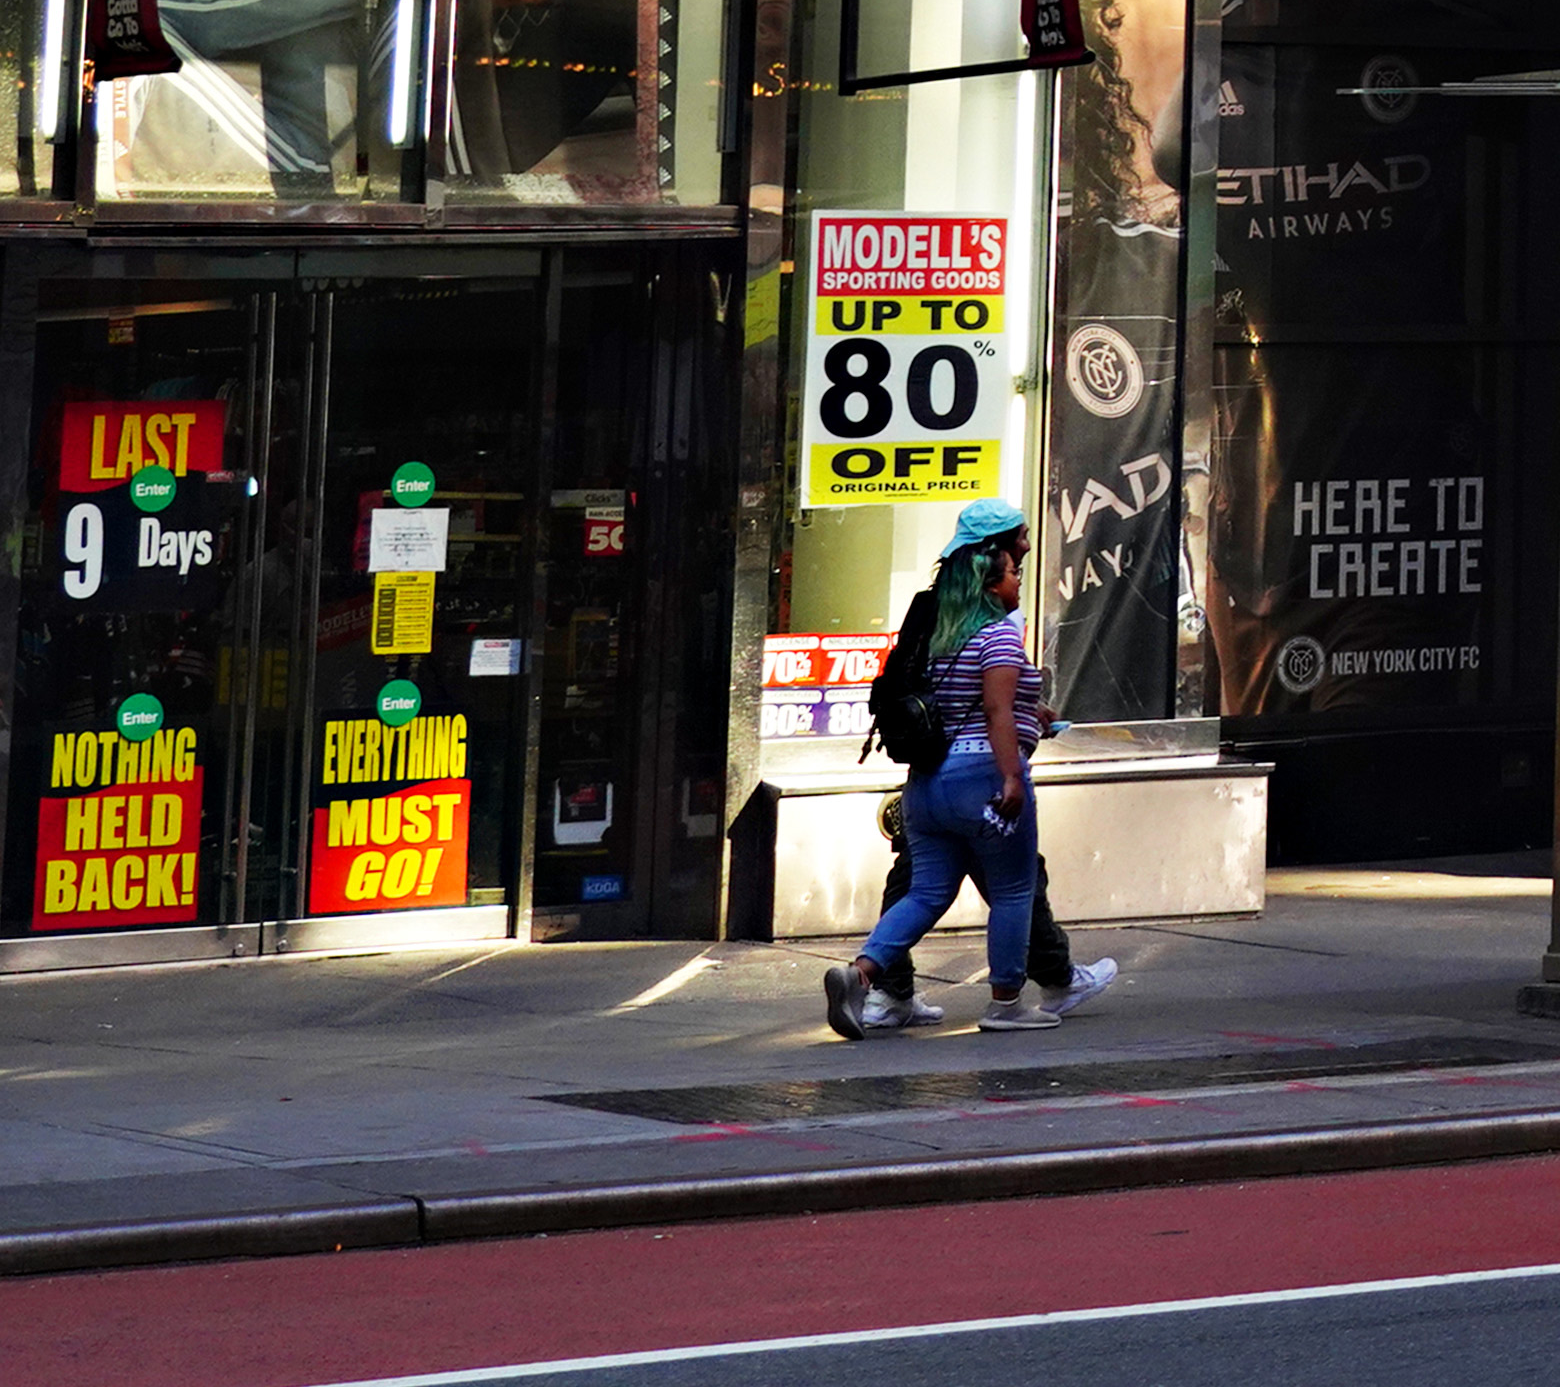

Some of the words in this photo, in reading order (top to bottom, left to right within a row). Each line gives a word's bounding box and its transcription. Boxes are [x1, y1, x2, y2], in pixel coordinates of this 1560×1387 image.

[1216, 154, 1431, 206] ETIHAD
[822, 224, 1002, 270] MODELL'S
[1248, 206, 1393, 239] AIRWAYS
[823, 270, 926, 291] SPORTING
[931, 270, 1001, 290] GOODS
[831, 300, 902, 332] UP
[920, 299, 990, 331] TO
[90, 413, 196, 479] LAST
[831, 445, 982, 480] OFF
[135, 483, 170, 497] Enter
[396, 479, 430, 493] Enter
[830, 482, 921, 494] ORIGINAL
[927, 479, 981, 491] PRICE
[1293, 479, 1411, 536] HERE
[1428, 477, 1484, 531] TO
[64, 502, 104, 599] 9
[138, 517, 213, 575] Days
[1310, 539, 1483, 598] CREATE
[1332, 651, 1369, 675] NEW
[1373, 648, 1416, 673] YORK
[1420, 647, 1456, 671] CITY
[1460, 645, 1480, 669] FC
[122, 711, 159, 725] Enter
[382, 695, 417, 712] Enter
[51, 727, 197, 788] NOTHING
[322, 714, 467, 785] EVERYTHING
[65, 793, 183, 851] HELD
[327, 793, 461, 848] MUST
[43, 852, 197, 914] BACK!
[344, 847, 444, 901] GO!
